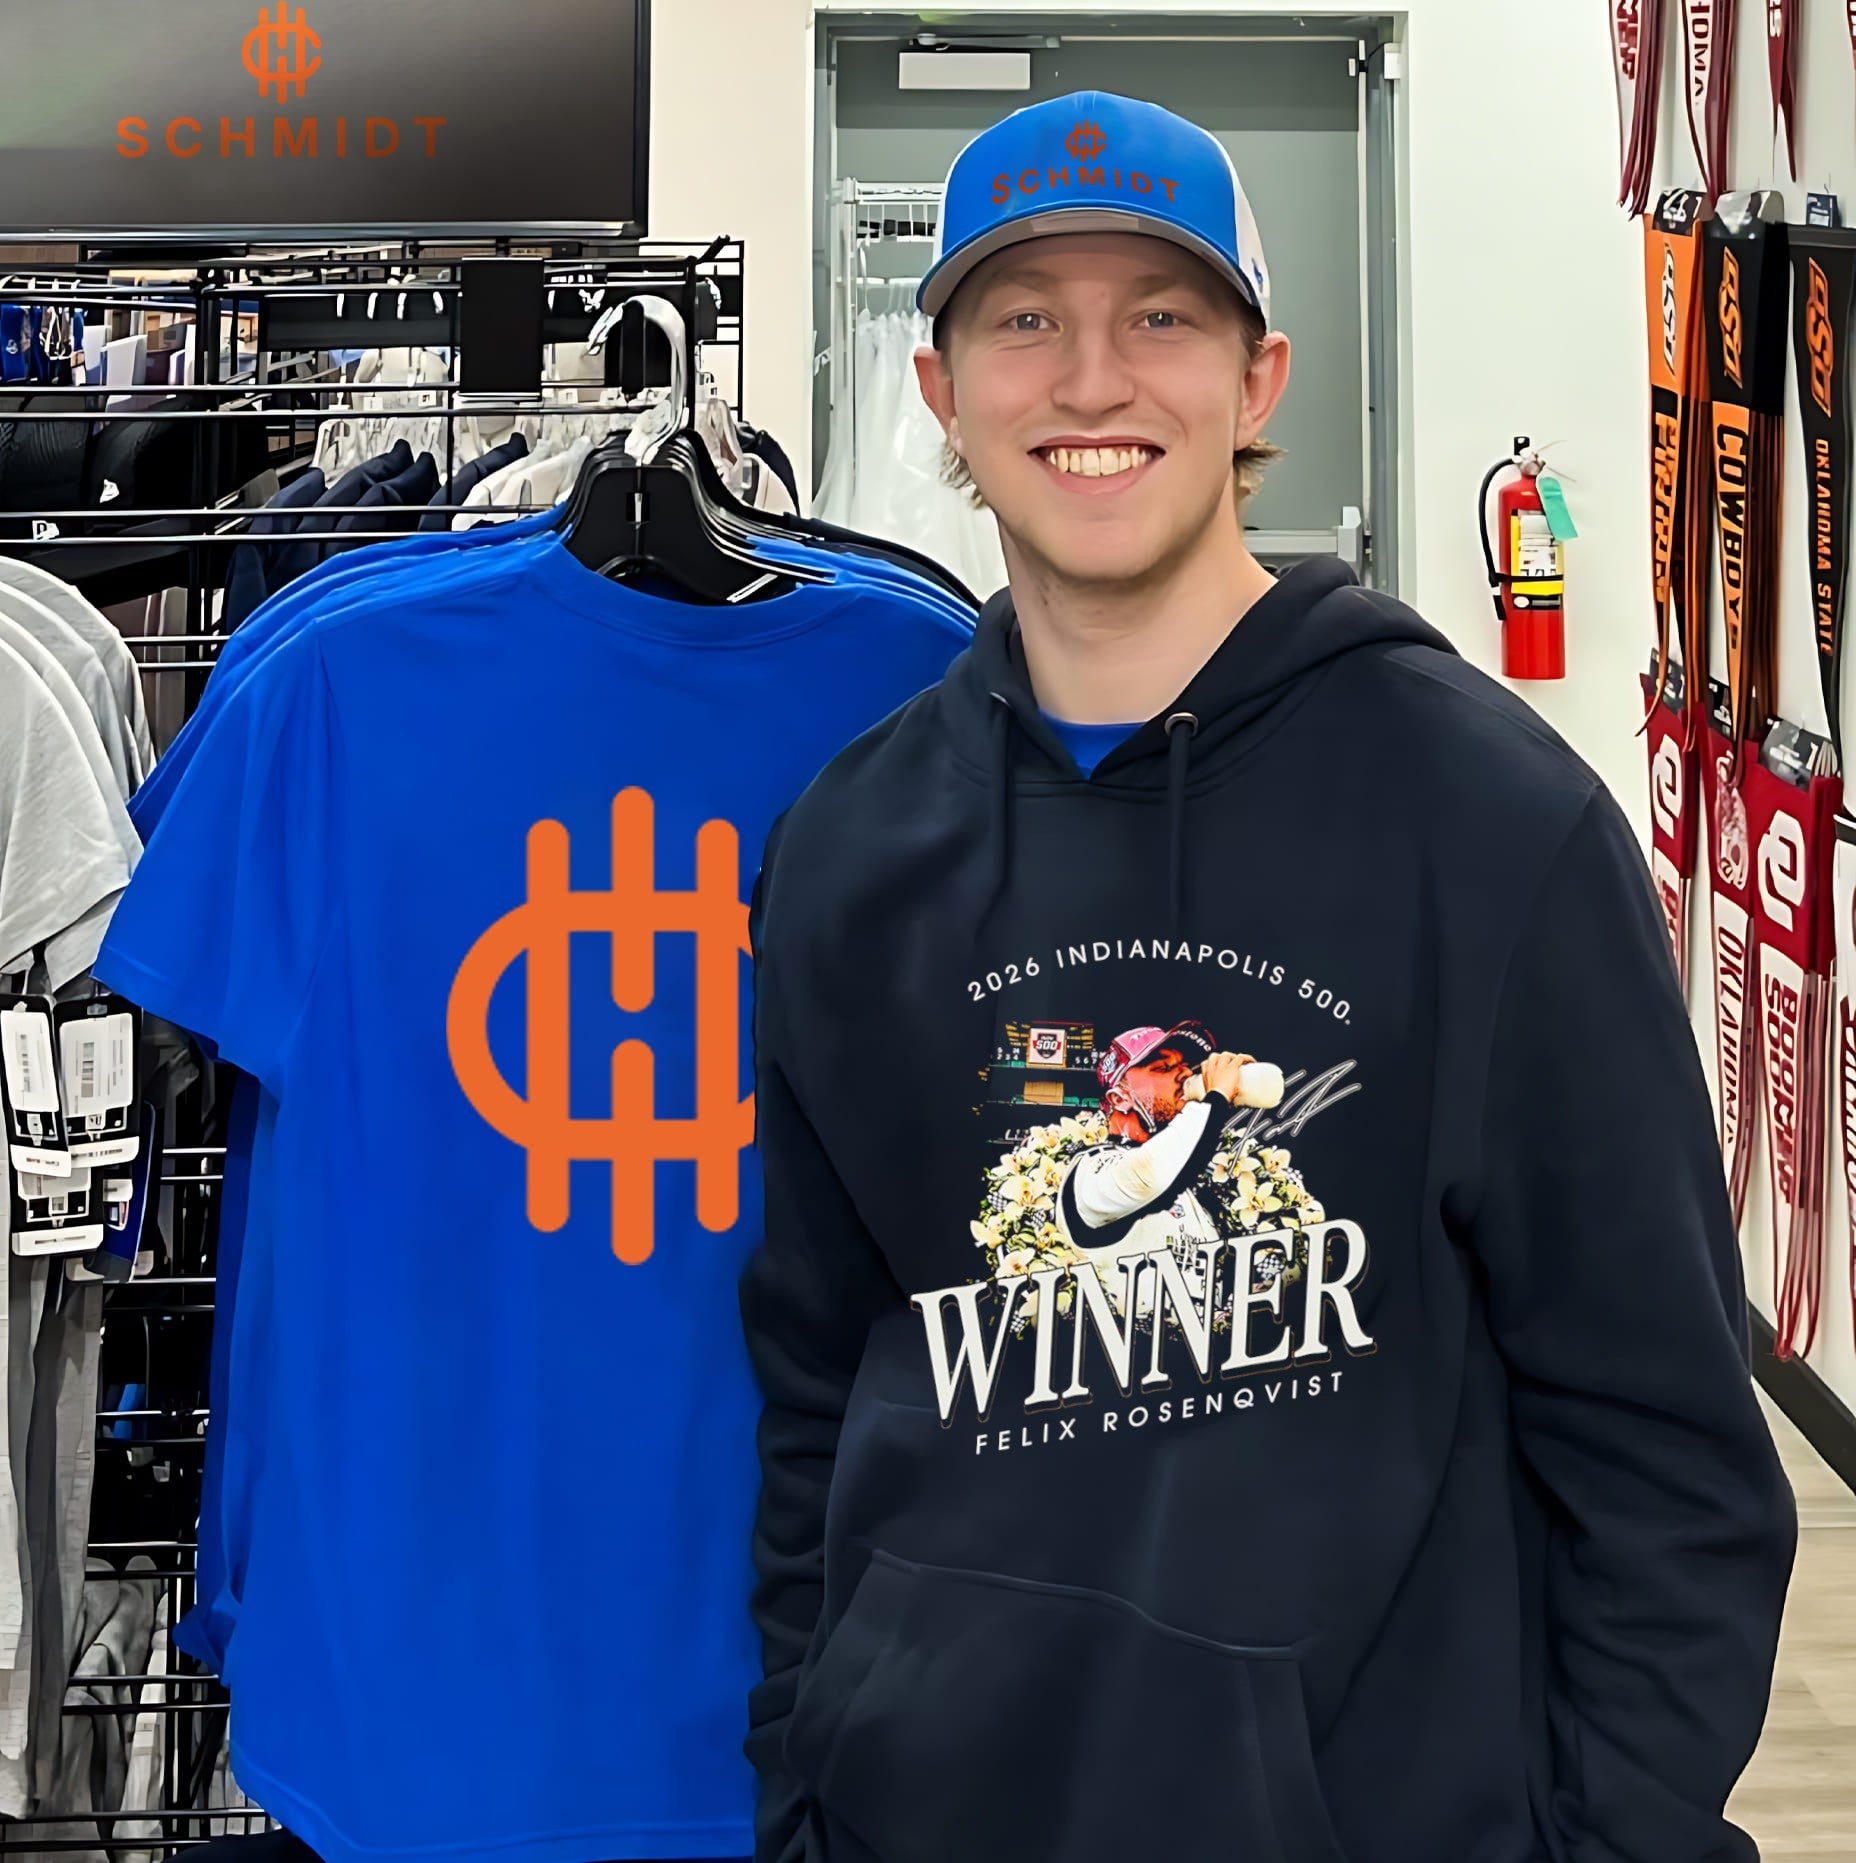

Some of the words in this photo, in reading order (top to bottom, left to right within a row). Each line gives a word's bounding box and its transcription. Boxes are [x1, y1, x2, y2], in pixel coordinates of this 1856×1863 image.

[115, 117, 447, 159] SCHMIDT
[991, 167, 1179, 204] SCHMIDT
[1814, 438, 1832, 570] OKLAHOMA
[1816, 582, 1833, 657] STATE
[967, 957, 1041, 1002] 2026
[1055, 938, 1286, 986] INDIANAPOLIS
[1036, 1040, 1058, 1051] 500
[1718, 925, 1745, 1144] OKLAHOMA
[911, 1218, 1377, 1424] WINNER
[975, 1417, 1077, 1456] FELIX
[1103, 1371, 1344, 1432] ROSENQVIST
